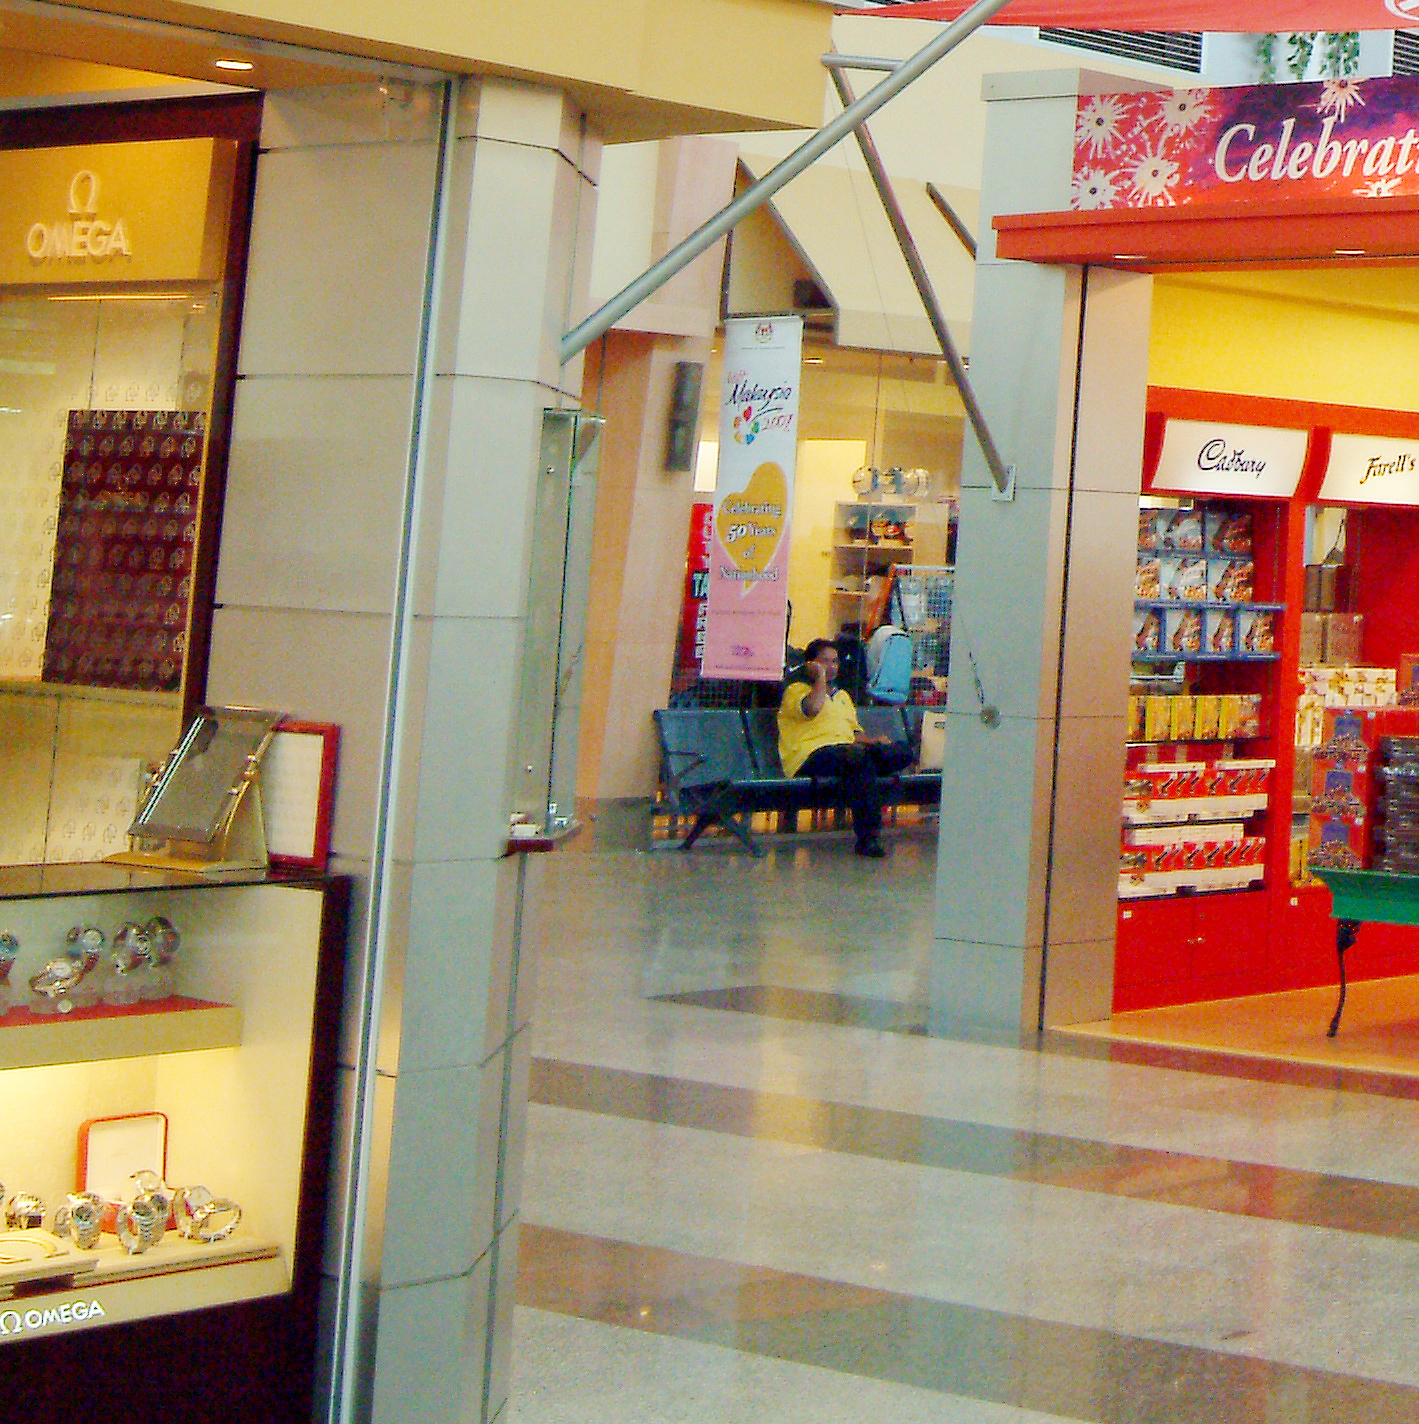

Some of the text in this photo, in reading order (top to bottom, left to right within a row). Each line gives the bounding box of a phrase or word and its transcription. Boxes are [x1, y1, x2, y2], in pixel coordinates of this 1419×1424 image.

[27, 218, 133, 258] OMEGA
[1197, 438, 1267, 479] Cadbury
[726, 522, 747, 543] 50
[24, 1299, 106, 1330] OMEGA
